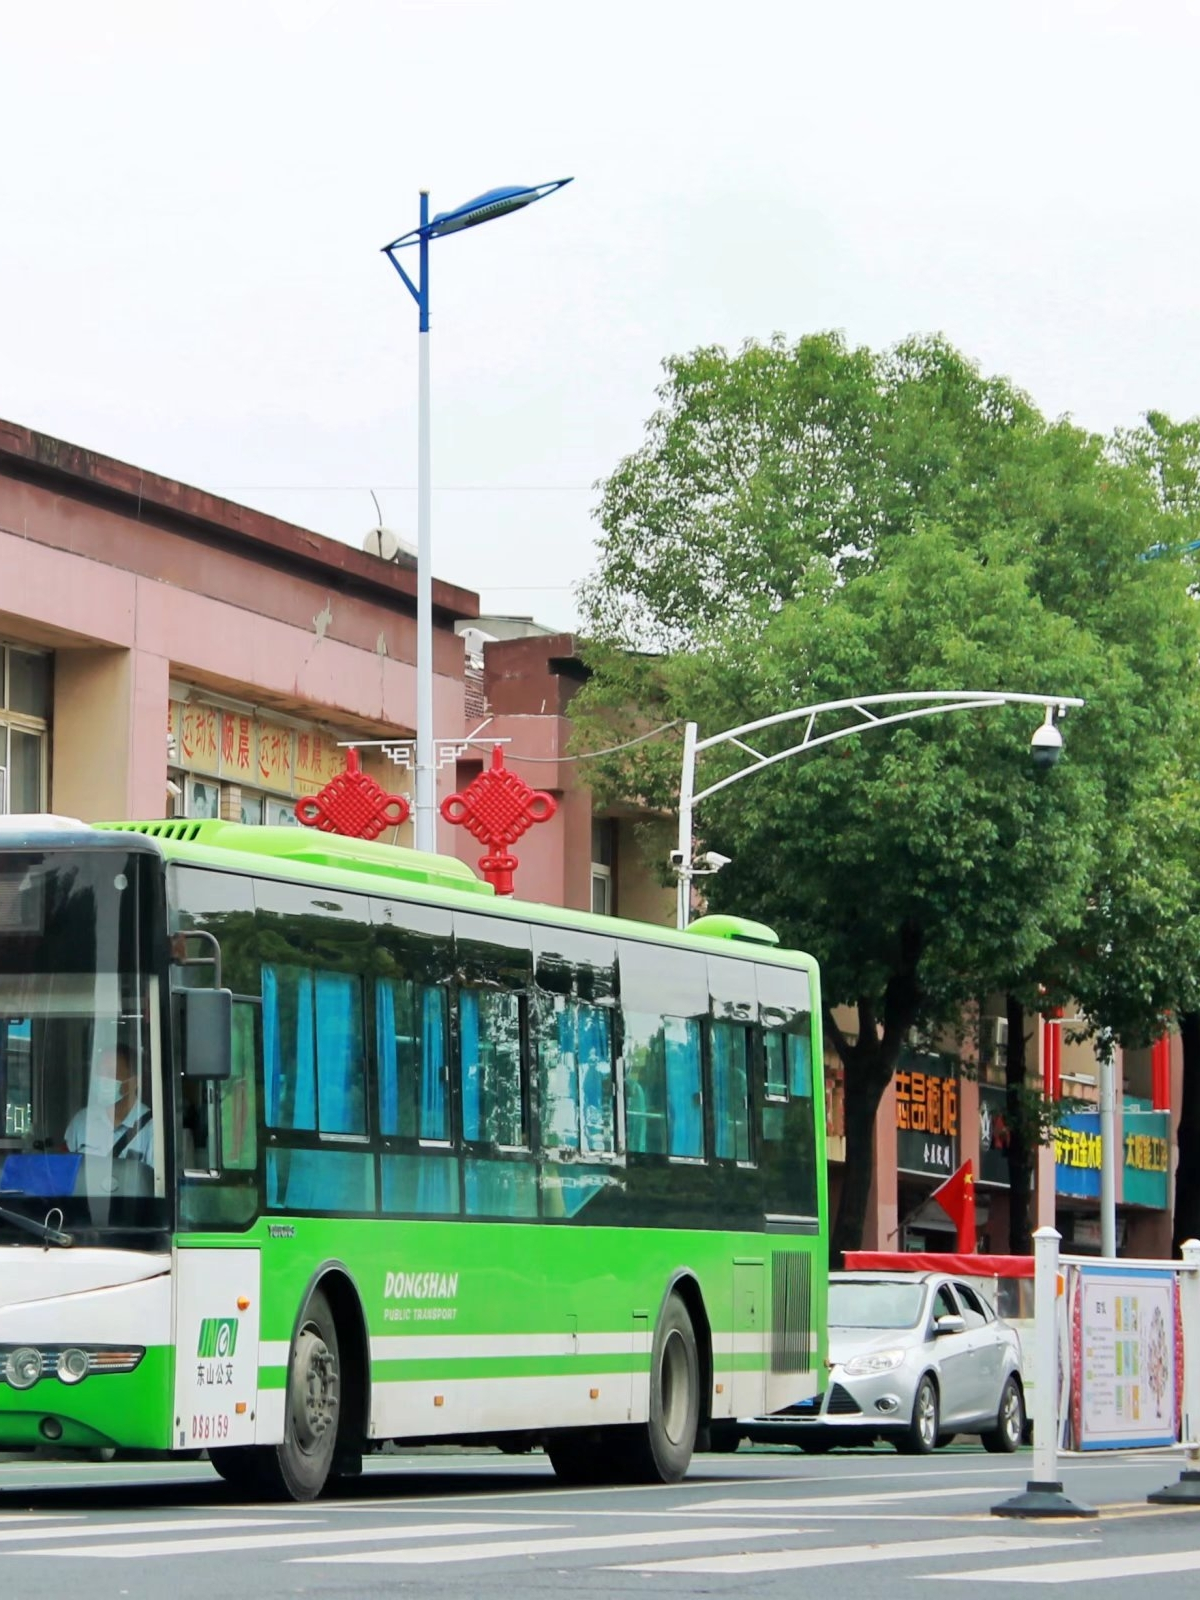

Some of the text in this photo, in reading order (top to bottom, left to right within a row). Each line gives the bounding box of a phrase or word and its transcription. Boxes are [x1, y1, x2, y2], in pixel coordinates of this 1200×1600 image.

[384, 1271, 459, 1299] DONGSHAN
[384, 1308, 458, 1321] PUBLIC TRANSPORT
[196, 1362, 234, 1386] 东山公交
[192, 1415, 230, 1440] DS8159
